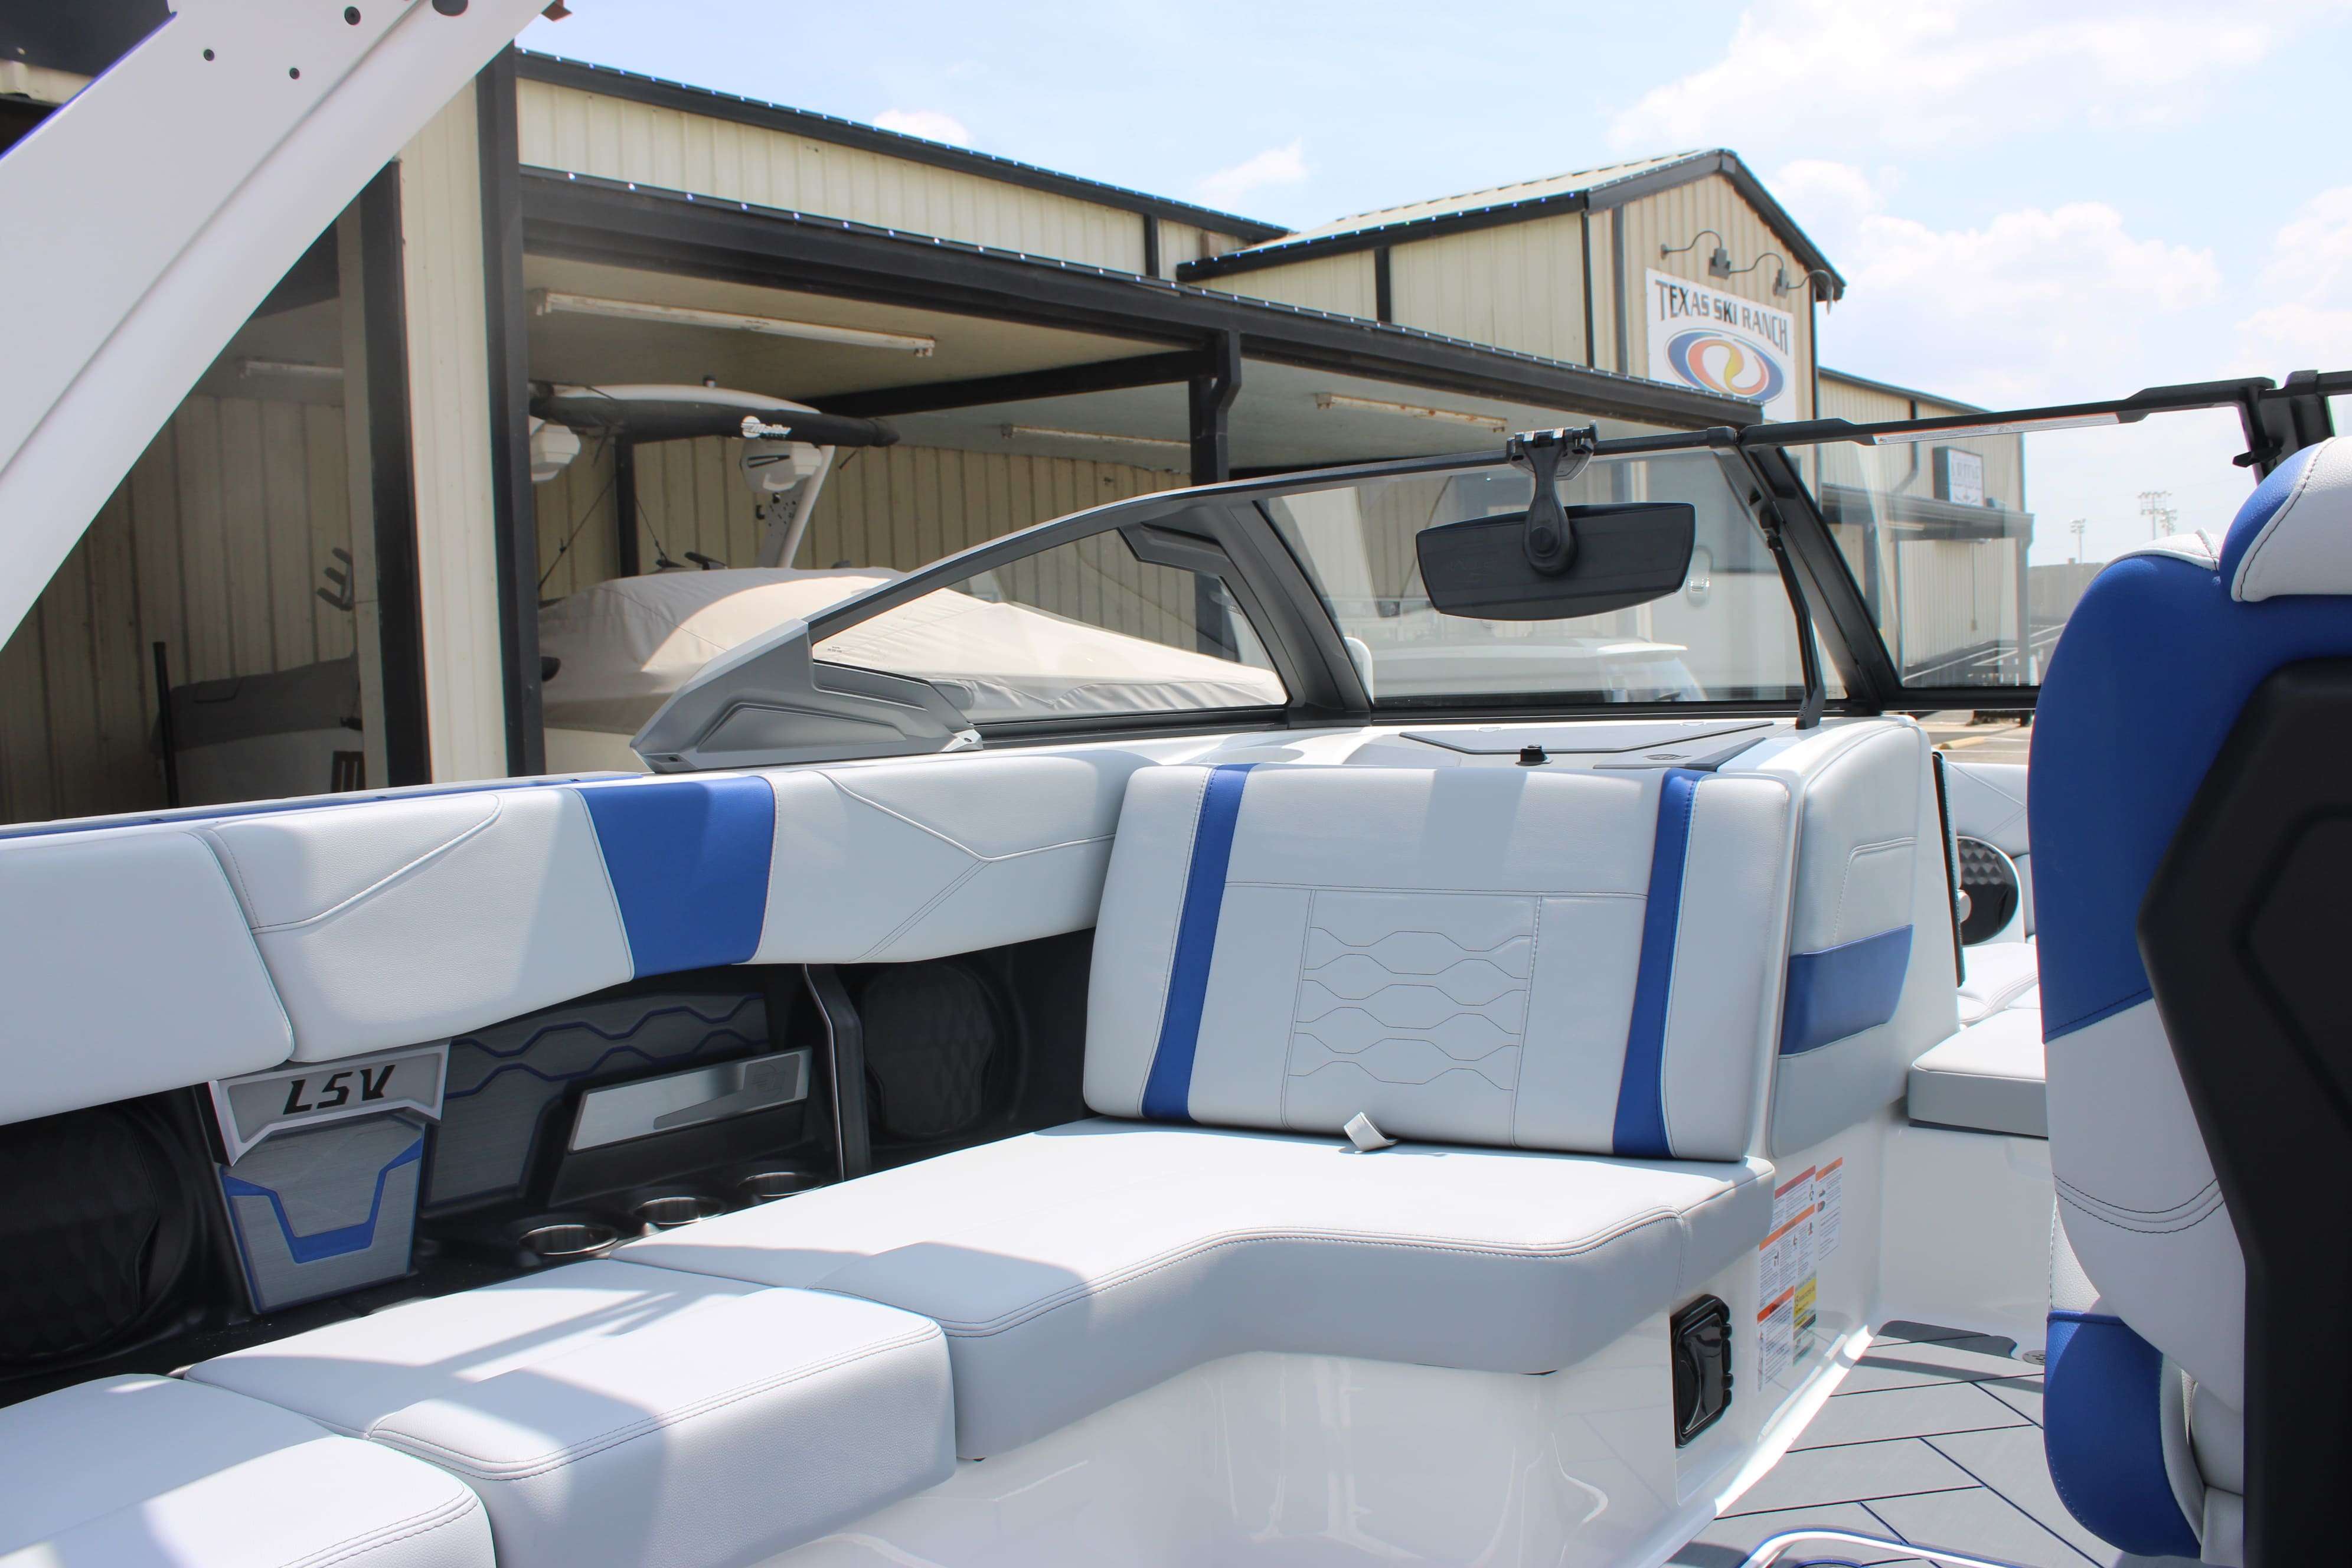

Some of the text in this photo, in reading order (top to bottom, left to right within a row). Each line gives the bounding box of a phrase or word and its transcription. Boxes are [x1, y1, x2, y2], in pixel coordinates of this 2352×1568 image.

[1655, 279, 1788, 356] TEXAS SKI RANCH
[283, 1064, 396, 1115] LSV
